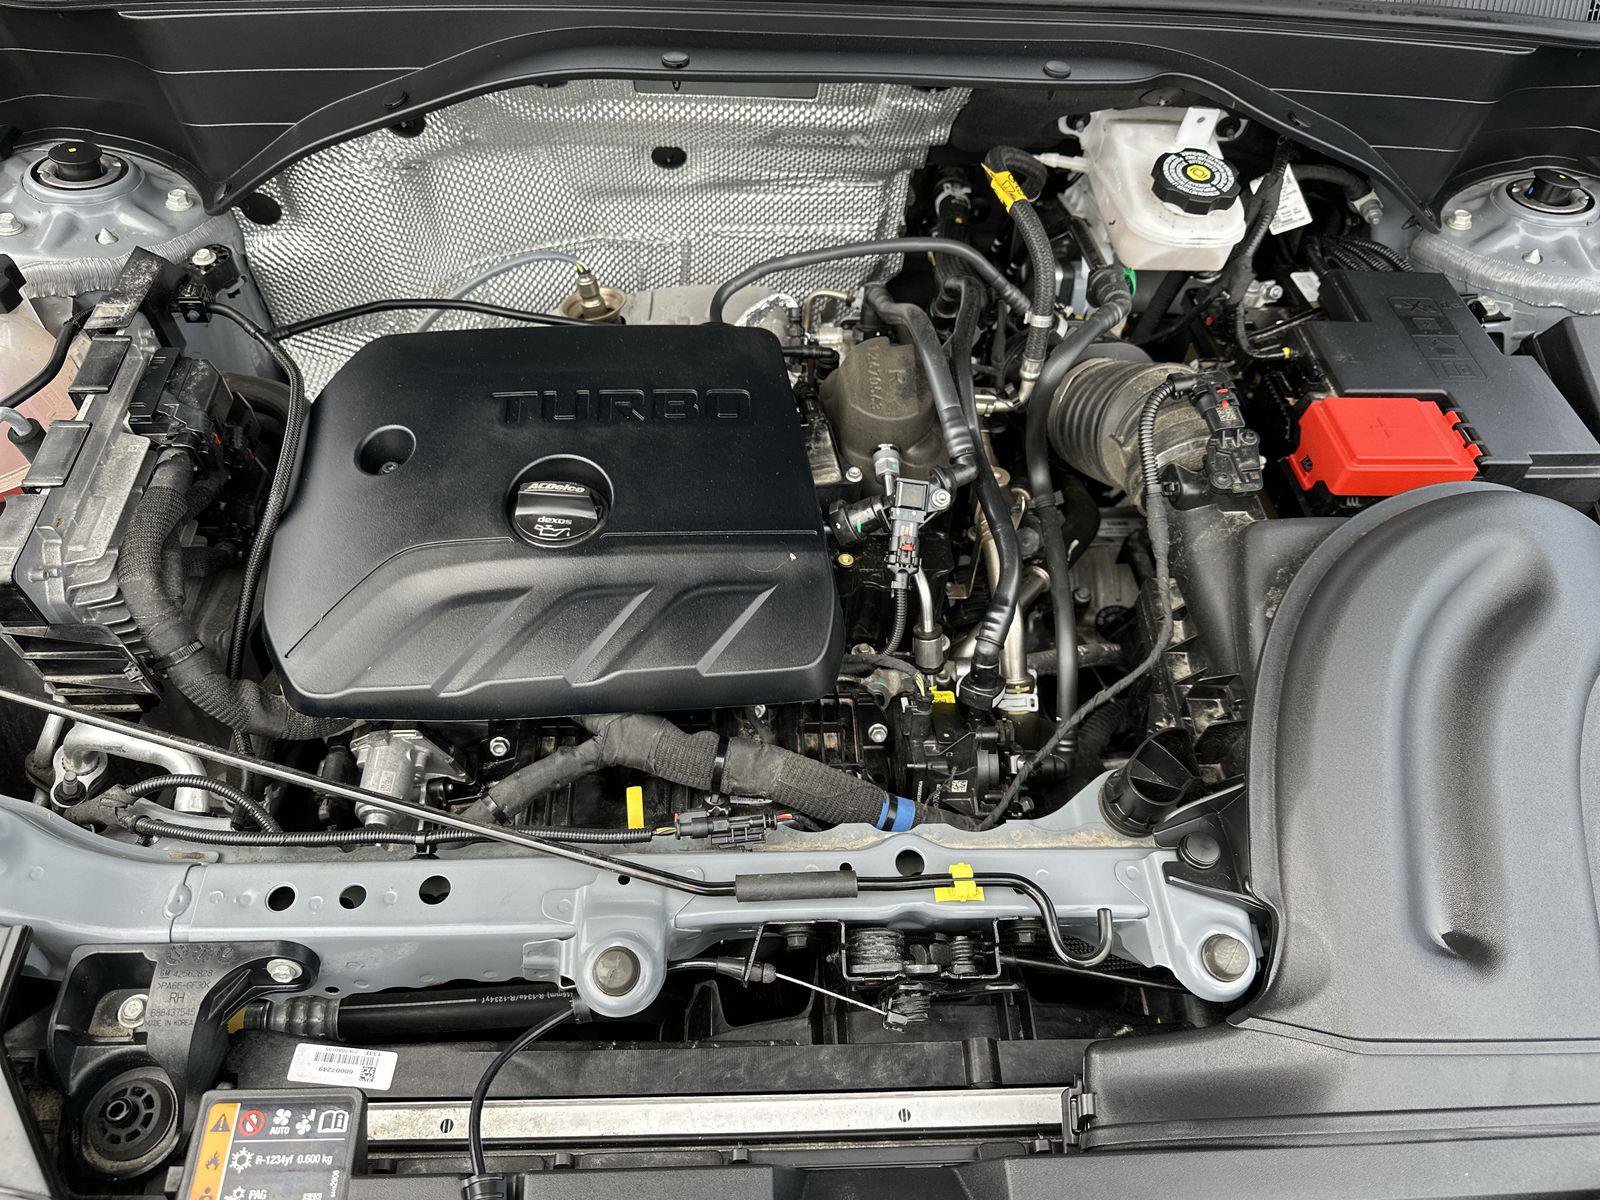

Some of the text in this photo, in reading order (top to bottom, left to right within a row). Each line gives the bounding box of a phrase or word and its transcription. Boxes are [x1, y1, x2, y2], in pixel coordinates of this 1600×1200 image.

[492, 389, 751, 424] TURBO
[528, 482, 586, 493] ACDelco
[537, 516, 573, 525] dexos
[169, 991, 186, 1003] RH
[269, 1126, 291, 1136] AUTO
[255, 1153, 333, 1166] R-1234yf 0.600 kg
[248, 1188, 268, 1200] PAG
